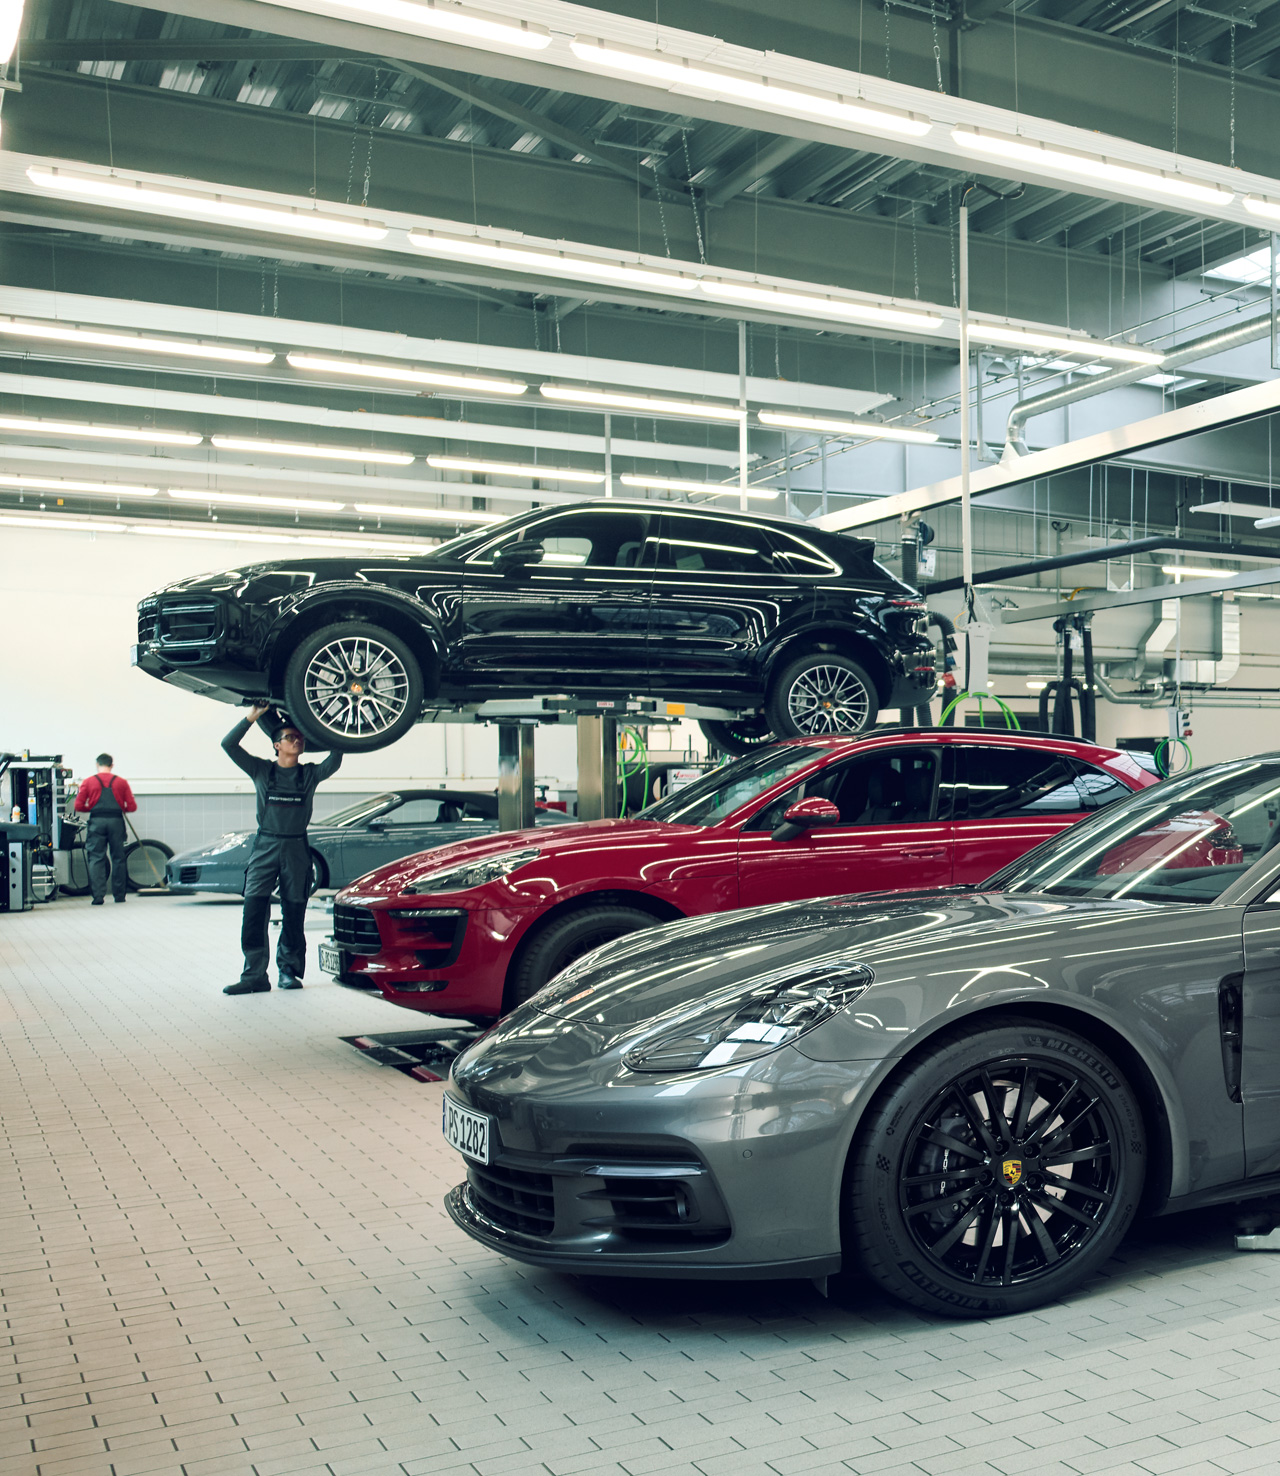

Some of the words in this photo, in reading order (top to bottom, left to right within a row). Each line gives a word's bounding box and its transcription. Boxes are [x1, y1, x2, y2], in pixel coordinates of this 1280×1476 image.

[1046, 1038, 1118, 1088] MICHELIN
[449, 1106, 458, 1144] PS
[460, 1115, 485, 1158] 1282
[902, 1264, 983, 1309] MICHELIN
